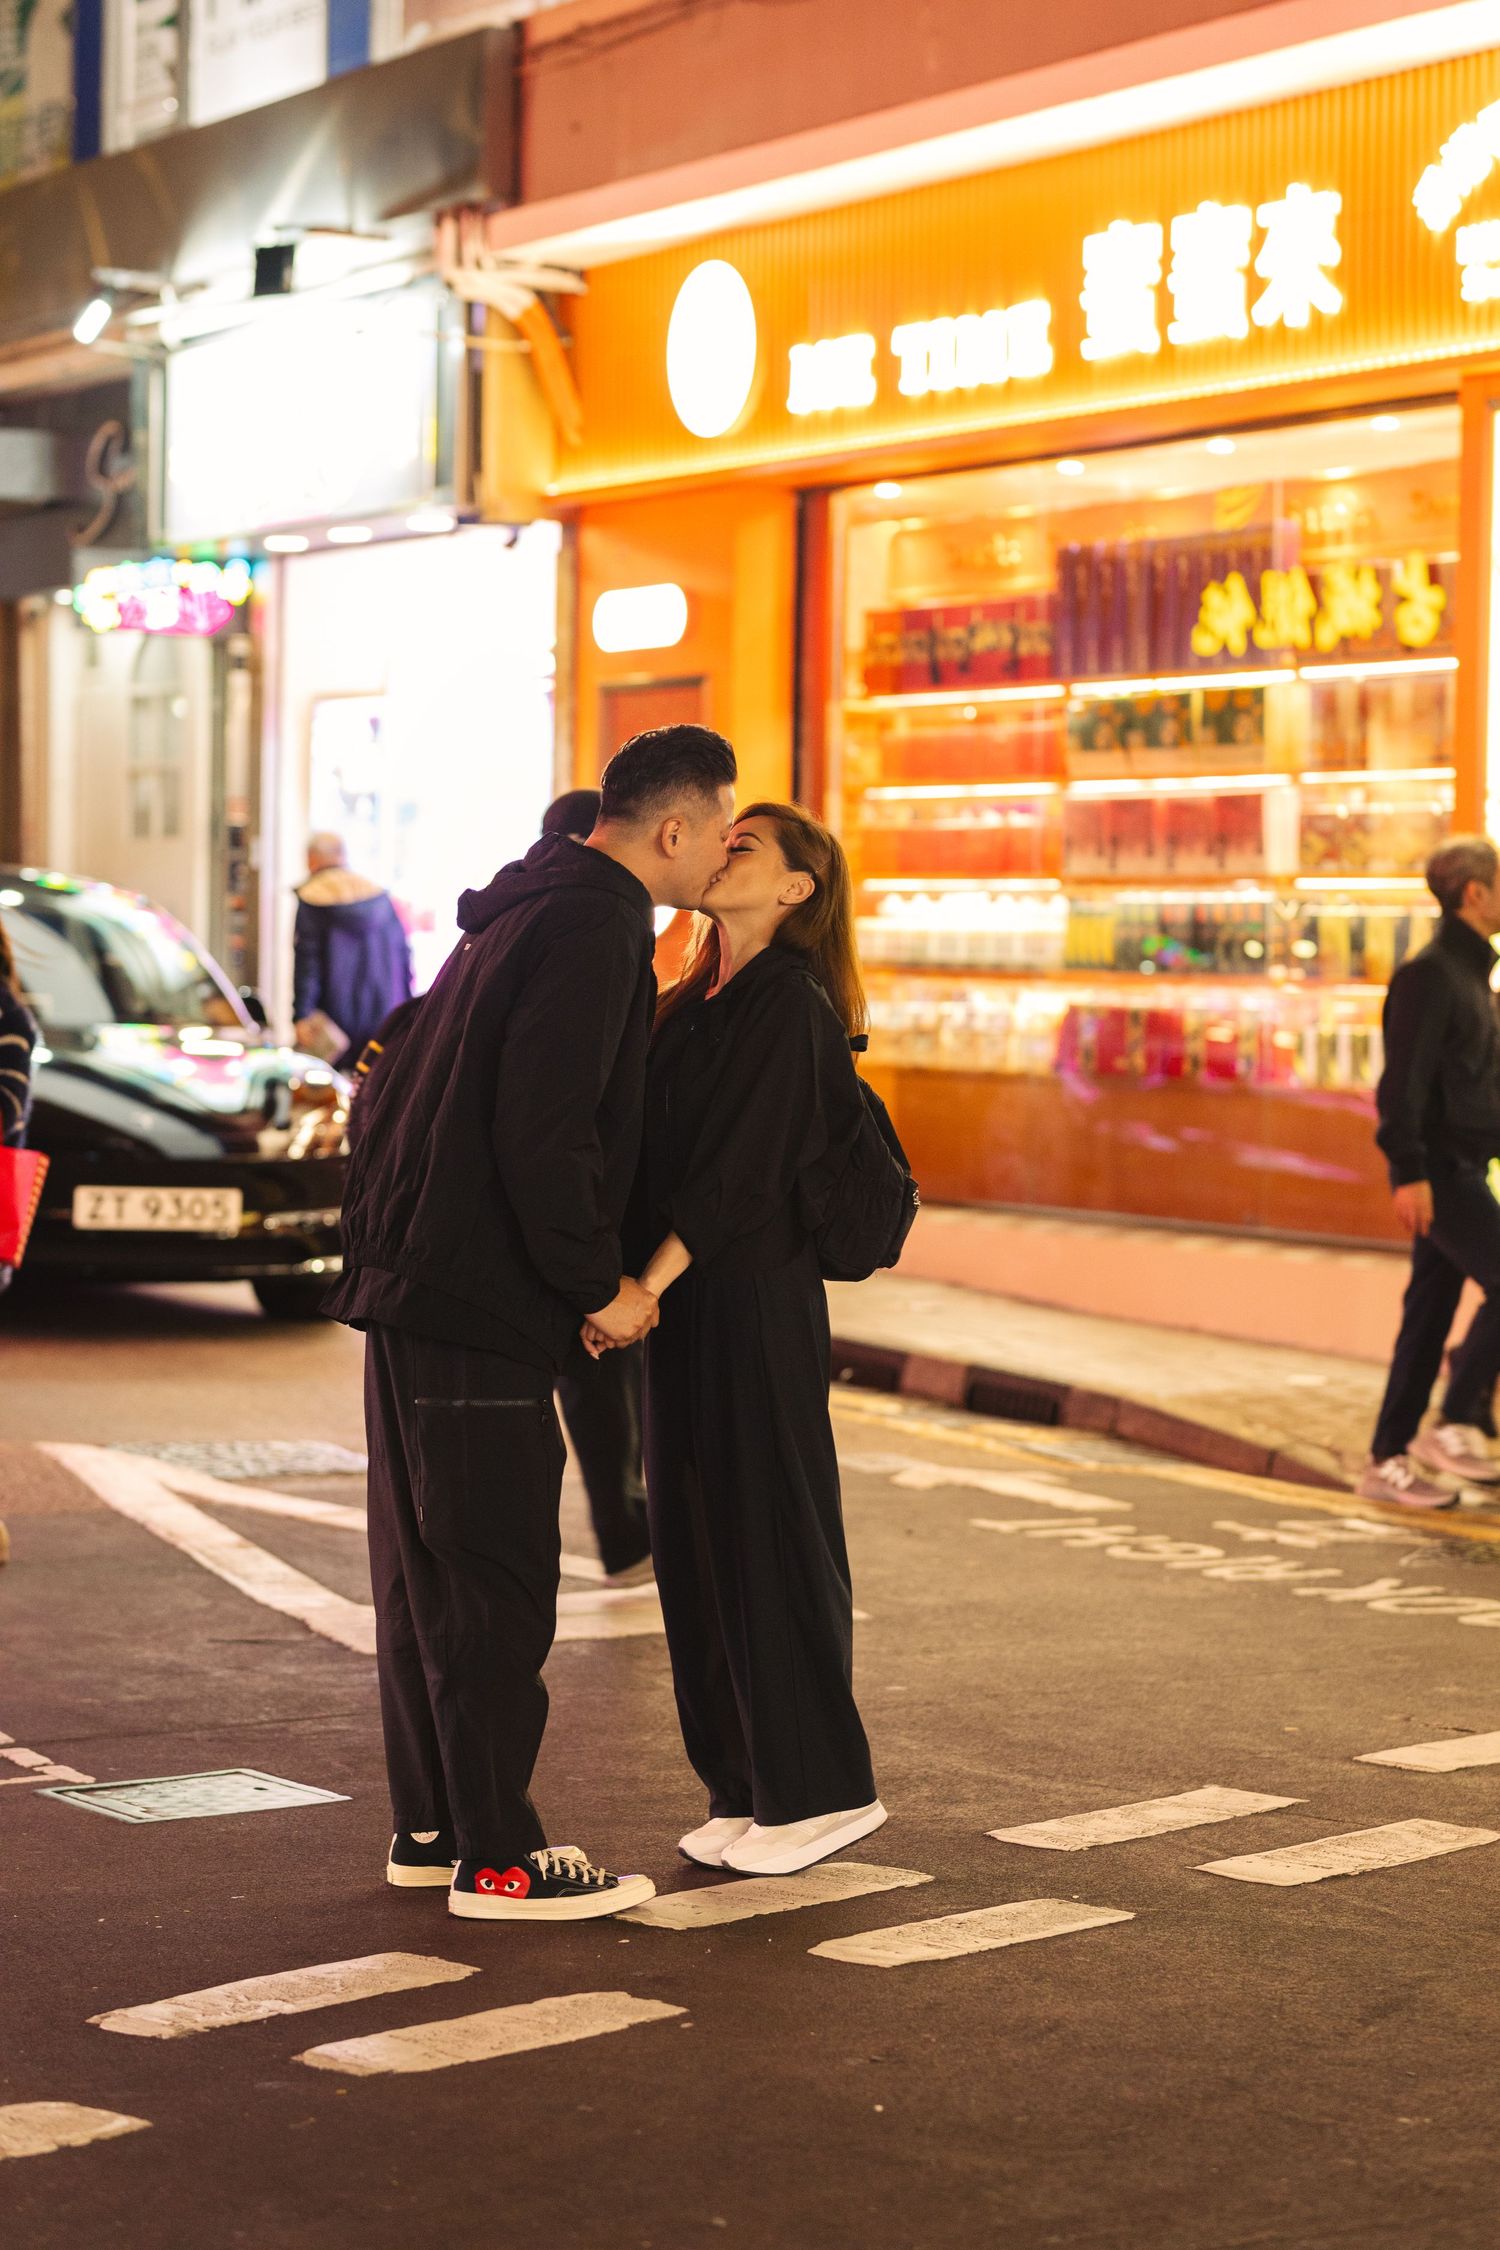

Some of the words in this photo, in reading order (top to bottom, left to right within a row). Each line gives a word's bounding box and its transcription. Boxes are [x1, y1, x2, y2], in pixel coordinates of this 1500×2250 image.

[87, 1194, 126, 1219] ZT
[144, 1195, 229, 1222] 9305
[969, 1517, 1344, 1580] RIGHT
